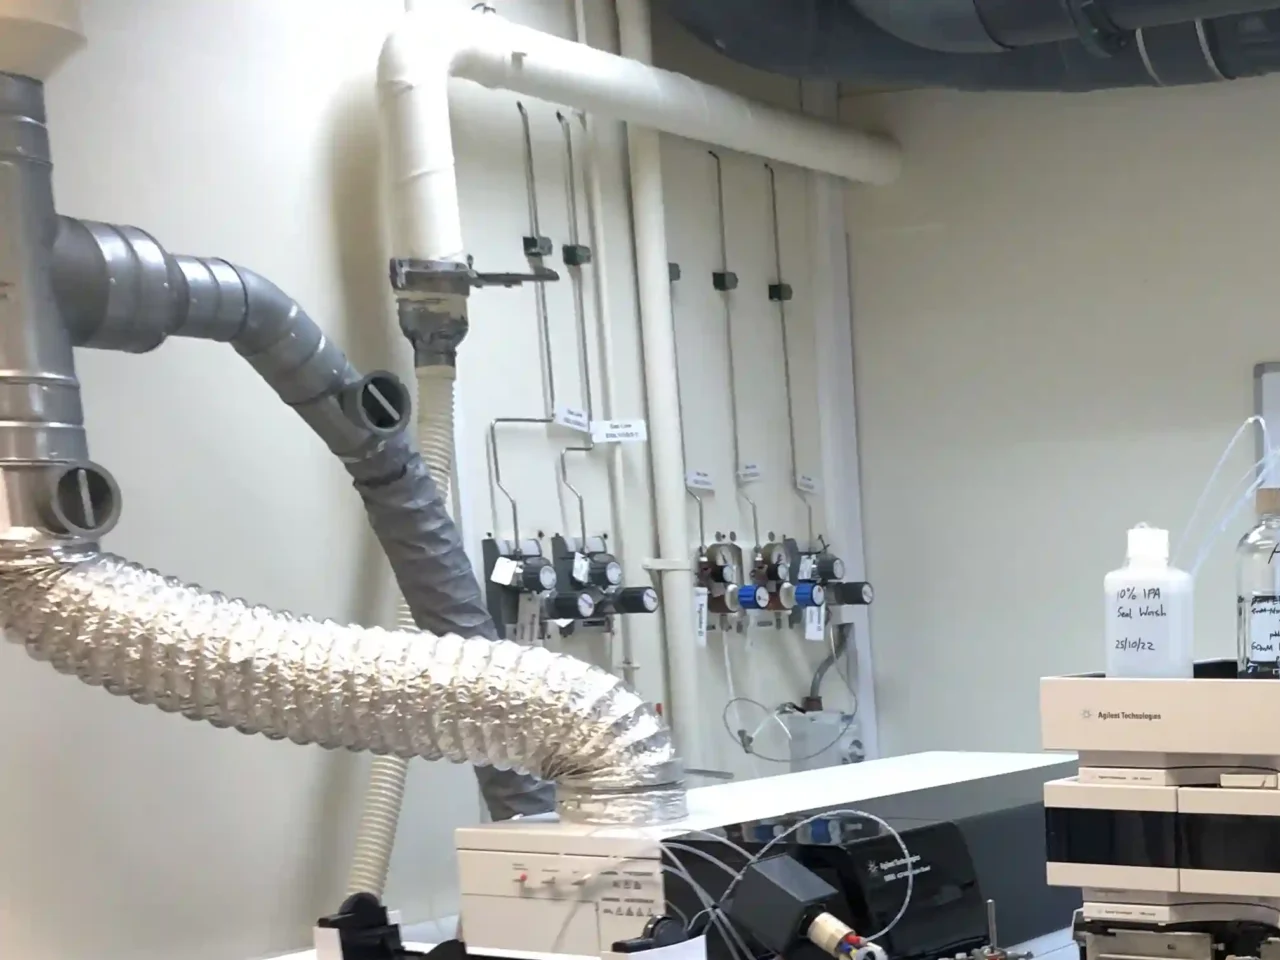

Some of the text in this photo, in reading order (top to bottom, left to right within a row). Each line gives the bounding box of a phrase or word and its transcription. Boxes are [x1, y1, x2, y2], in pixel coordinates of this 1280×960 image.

[1116, 586, 1161, 602] 10% IPA
[1139, 603, 1166, 617] Wash
[1115, 637, 1156, 652] 25/10/22
[1098, 711, 1162, 721] Agilent Technologies
